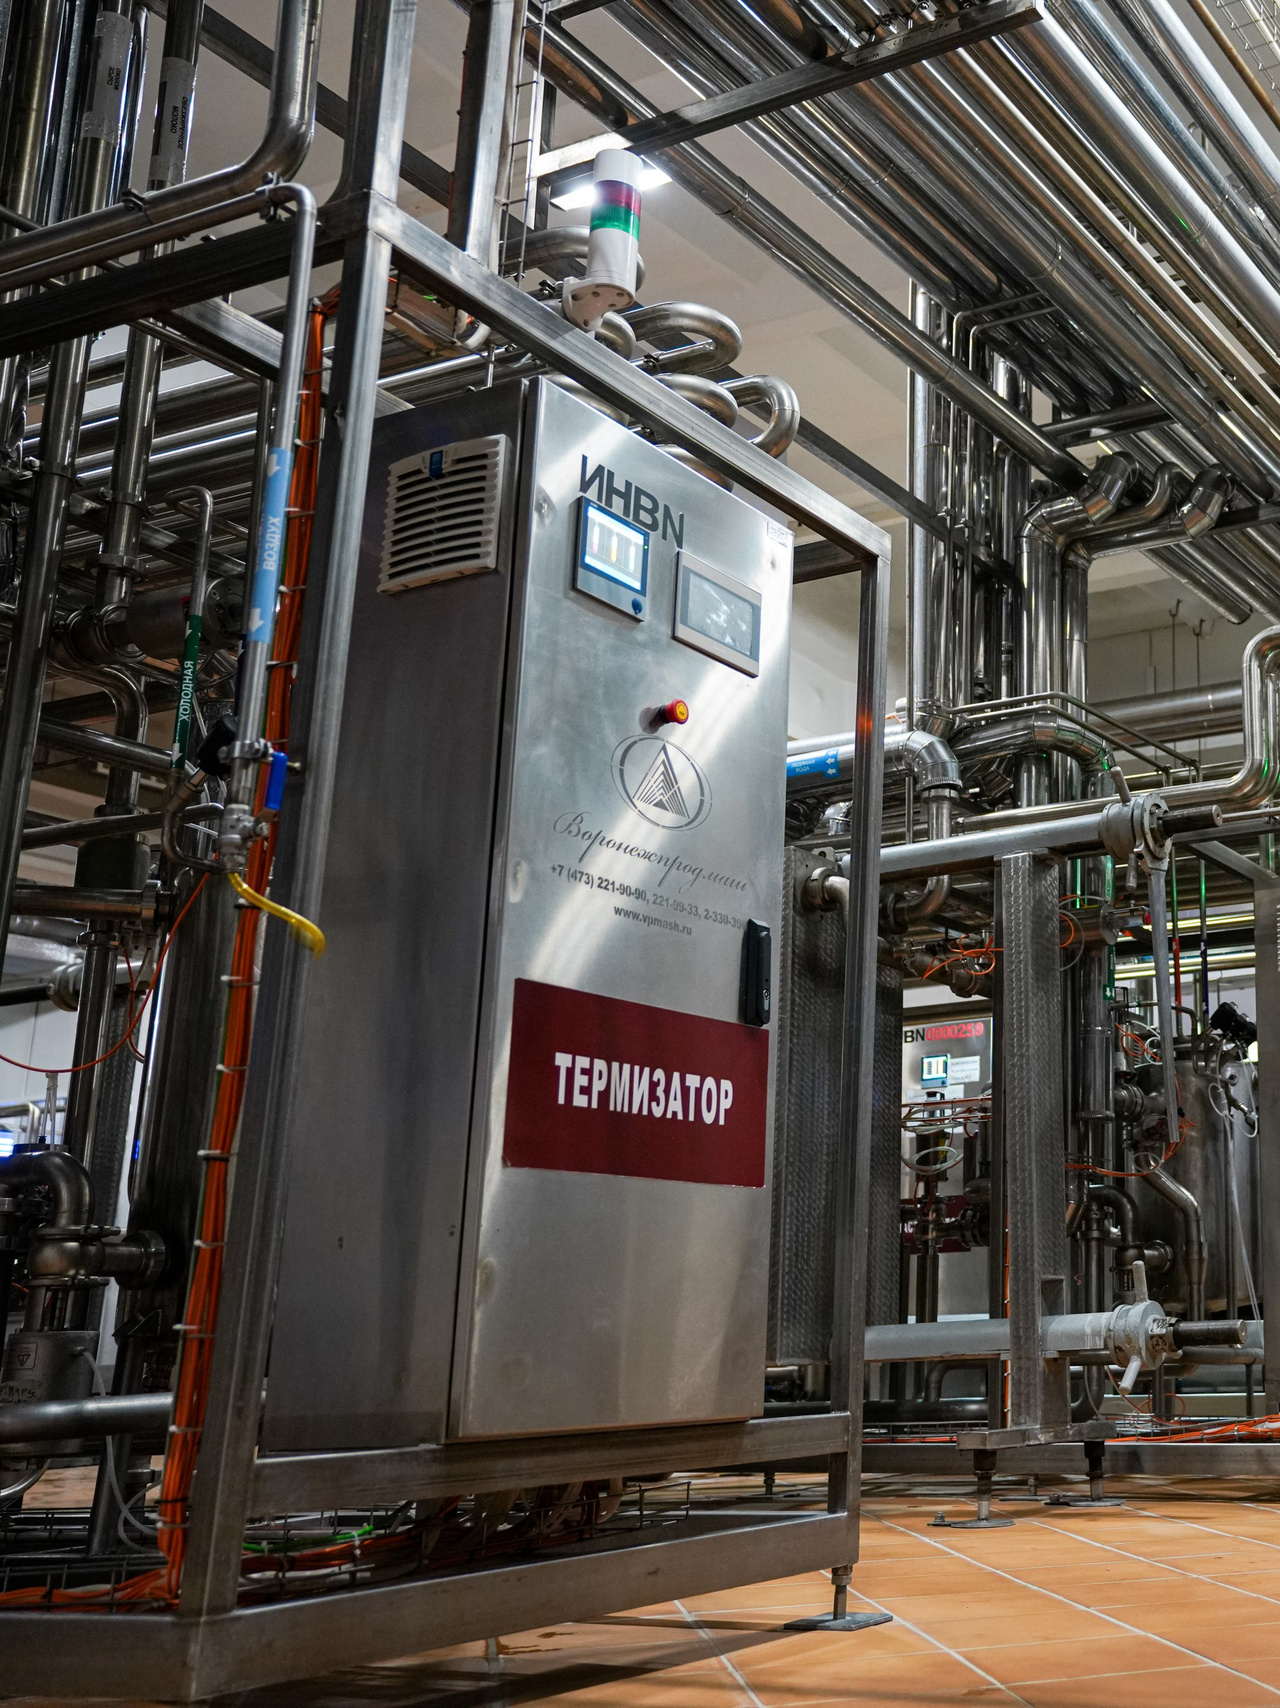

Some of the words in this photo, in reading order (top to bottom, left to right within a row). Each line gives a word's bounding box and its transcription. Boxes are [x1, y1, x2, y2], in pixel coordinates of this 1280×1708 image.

[170, 105, 179, 134] МОЛОКО
[262, 515, 281, 571] ВОЗДУХ
[180, 660, 194, 722] ХОЛОДНАЯ
[553, 811, 748, 894] Воронежпродмаш
[551, 865, 564, 877] +7
[567, 868, 594, 889] (473)
[597, 877, 649, 905] 221-90-90,
[614, 906, 692, 936] www.vpmash.ru
[555, 1052, 733, 1125] ТЕРМИЗАТОР
